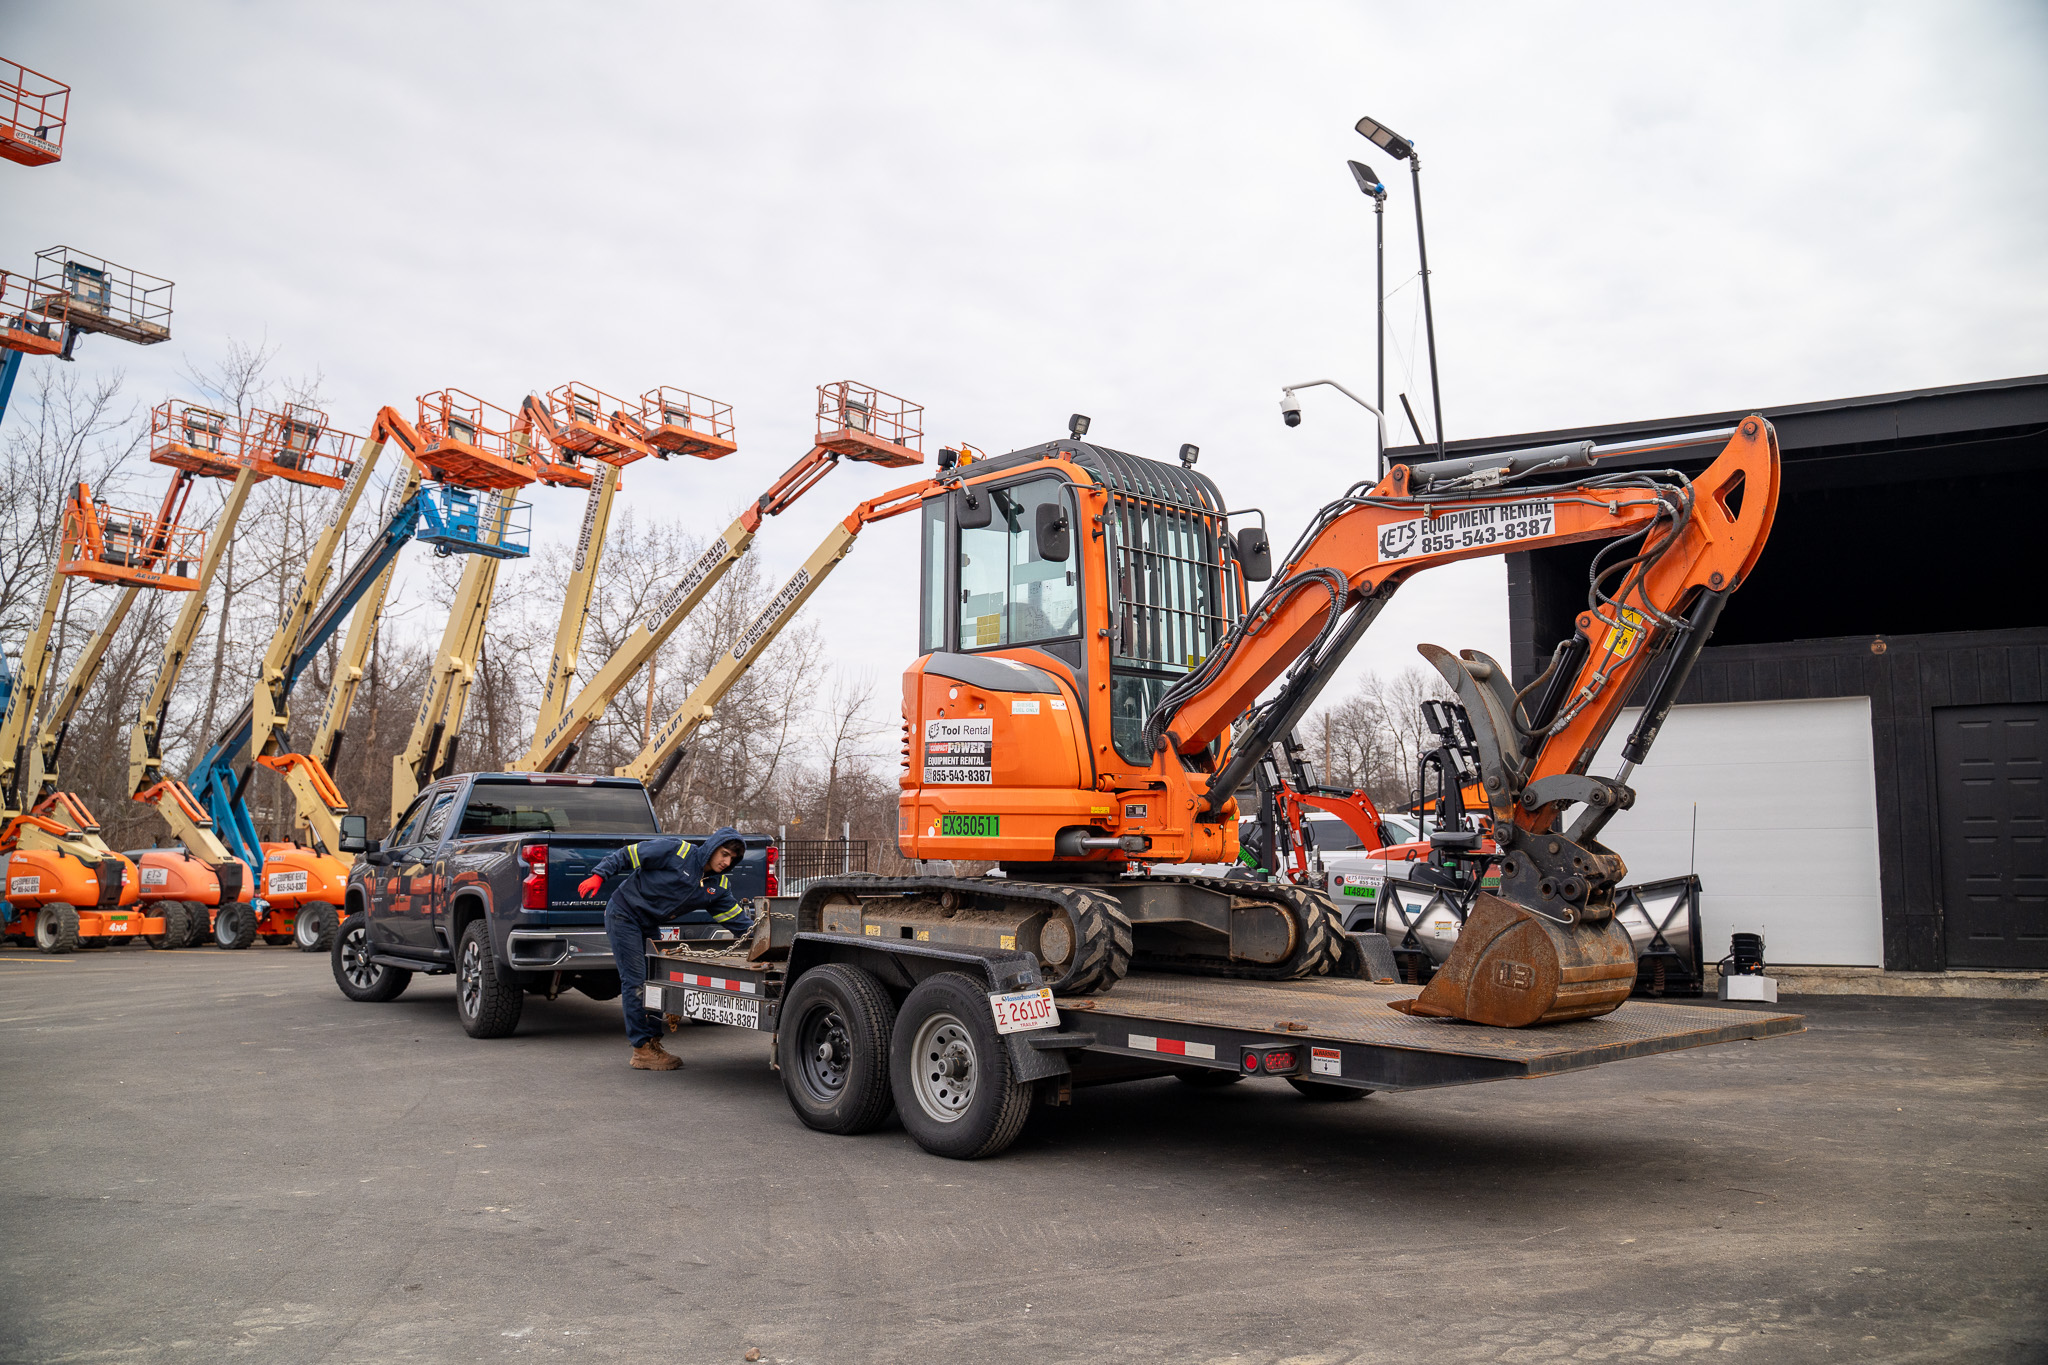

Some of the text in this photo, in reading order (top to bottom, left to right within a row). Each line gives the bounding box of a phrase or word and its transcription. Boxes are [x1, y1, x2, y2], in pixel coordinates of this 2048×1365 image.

[577, 498, 595, 551] EQUIPMENT
[590, 464, 602, 497] RENTAL
[1386, 498, 1552, 547] ETS EQUIPMENT RENTAL
[1421, 516, 1552, 554] 855-543-8387
[648, 538, 727, 627] ETS EQUIPMENT RENTAL
[664, 545, 728, 618] 855-543-8387
[281, 575, 308, 633] JLG LIFT
[734, 568, 808, 656] ETS EQUIPMENT RENTAL
[749, 575, 810, 646] 855-543-8387
[7, 662, 26, 724] JLG LIFT
[546, 652, 561, 702] JLG LIFT
[322, 684, 338, 731] JLG LIFT
[420, 675, 437, 726] JLG LIFT
[544, 708, 575, 749] JLG LIFT
[653, 712, 683, 753] JLG LIFT
[941, 726, 960, 736] Tool
[963, 725, 990, 735] Rental
[948, 742, 986, 753] POWER
[927, 756, 985, 766] EQUIPMENT RENTAL
[932, 769, 991, 782] 855-543-8387
[942, 815, 999, 836] EX350511
[147, 870, 161, 880] ETS
[1344, 887, 1375, 898] LT48214
[109, 922, 127, 932] 4x4
[687, 991, 758, 1014] ETS EQUIPMENT RENTAL
[1004, 993, 1038, 1002] Massachusetts
[1010, 998, 1051, 1022] 2610F
[702, 1007, 757, 1029] 855-543-8387
